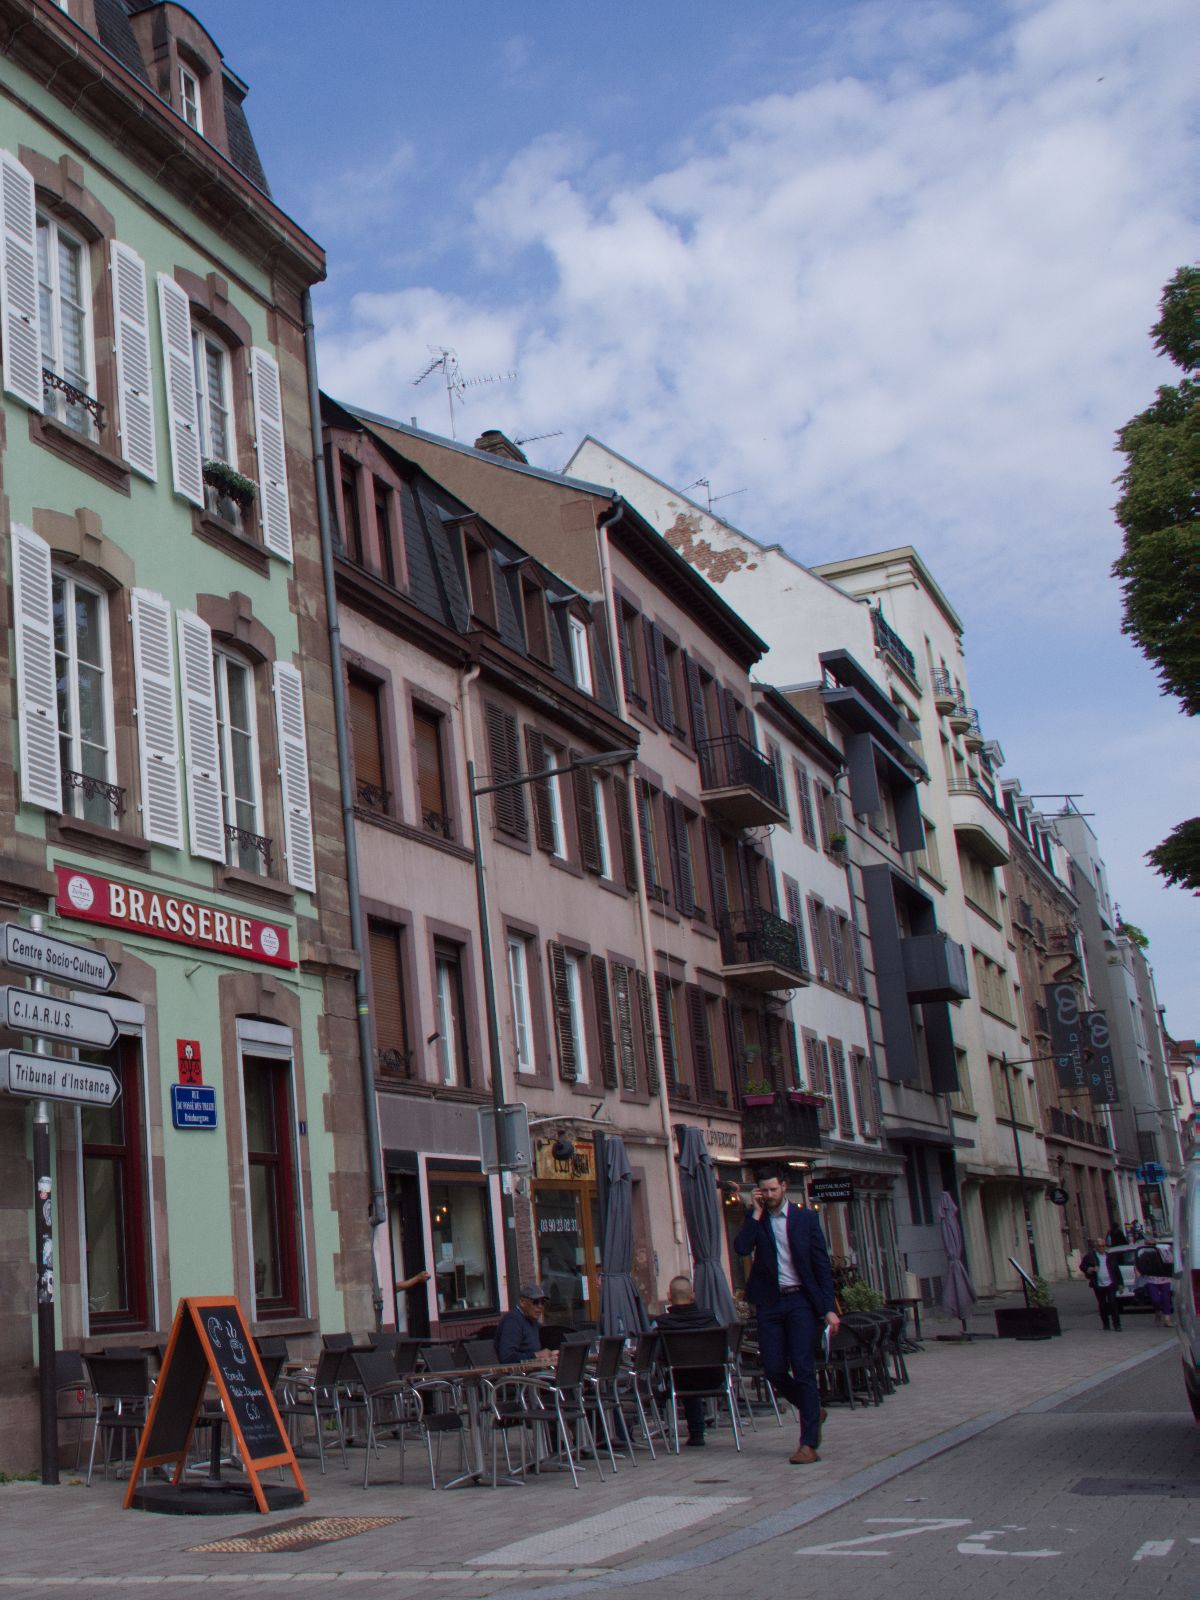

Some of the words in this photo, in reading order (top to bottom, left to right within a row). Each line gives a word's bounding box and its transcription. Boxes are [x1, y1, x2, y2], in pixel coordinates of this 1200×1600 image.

[108, 883, 253, 950] BRASSERIE
[12, 938, 42, 958] Centre
[46, 948, 106, 979] Socio-Culturel
[13, 1000, 74, 1029] C.I.A.R.U.S.
[15, 1064, 56, 1086] Tribunal
[61, 1072, 110, 1095] d'Instance
[1071, 1047, 1086, 1085] HOTEL
[1103, 1064, 1117, 1101] HOTEL
